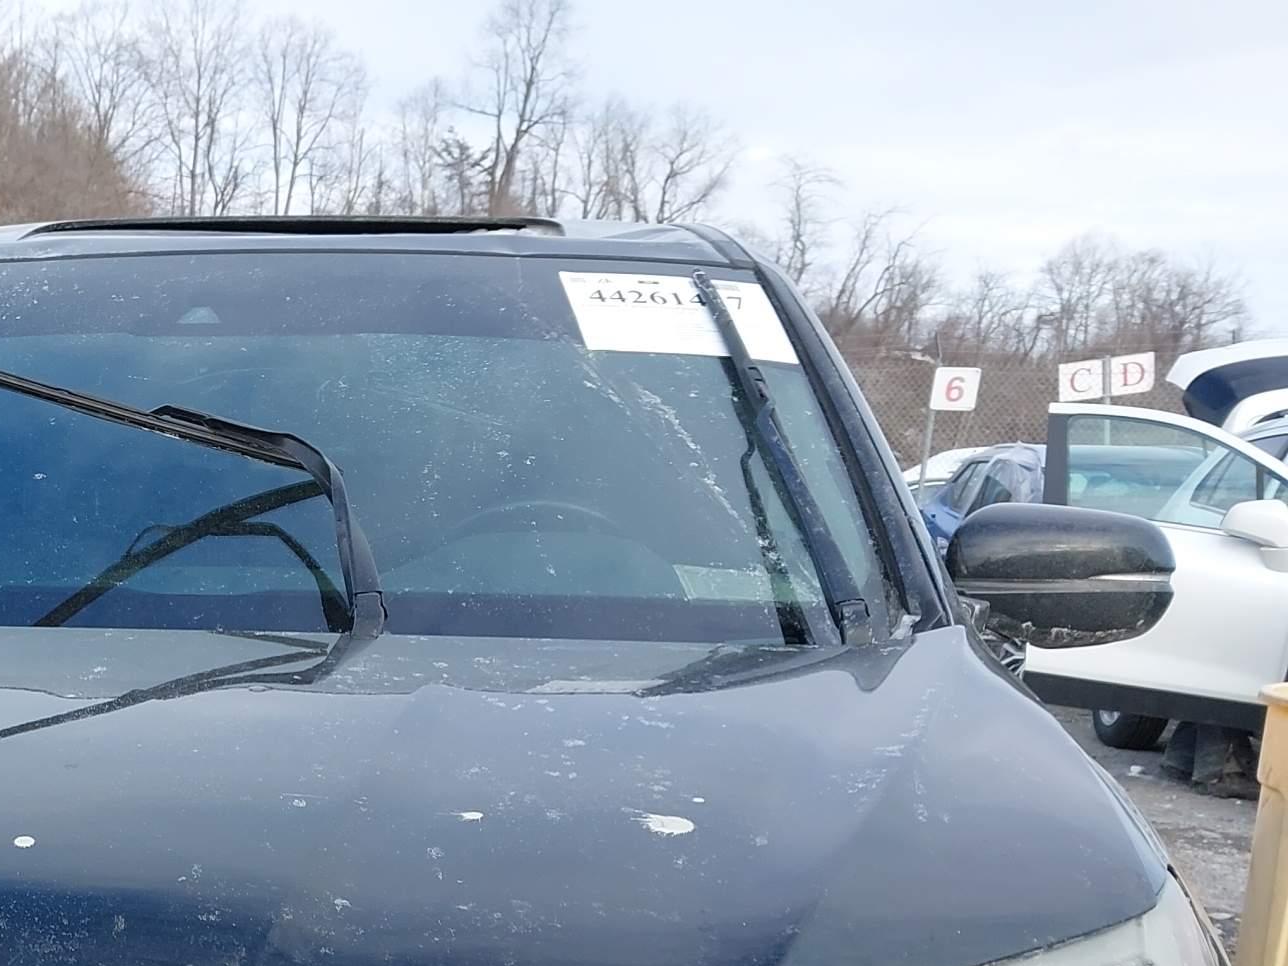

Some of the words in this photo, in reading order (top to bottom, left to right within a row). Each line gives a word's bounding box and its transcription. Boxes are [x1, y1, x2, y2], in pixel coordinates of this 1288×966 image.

[589, 289, 742, 310] 4426147
[1070, 368, 1092, 393] C
[1120, 362, 1145, 387] D
[945, 376, 966, 402] 6
